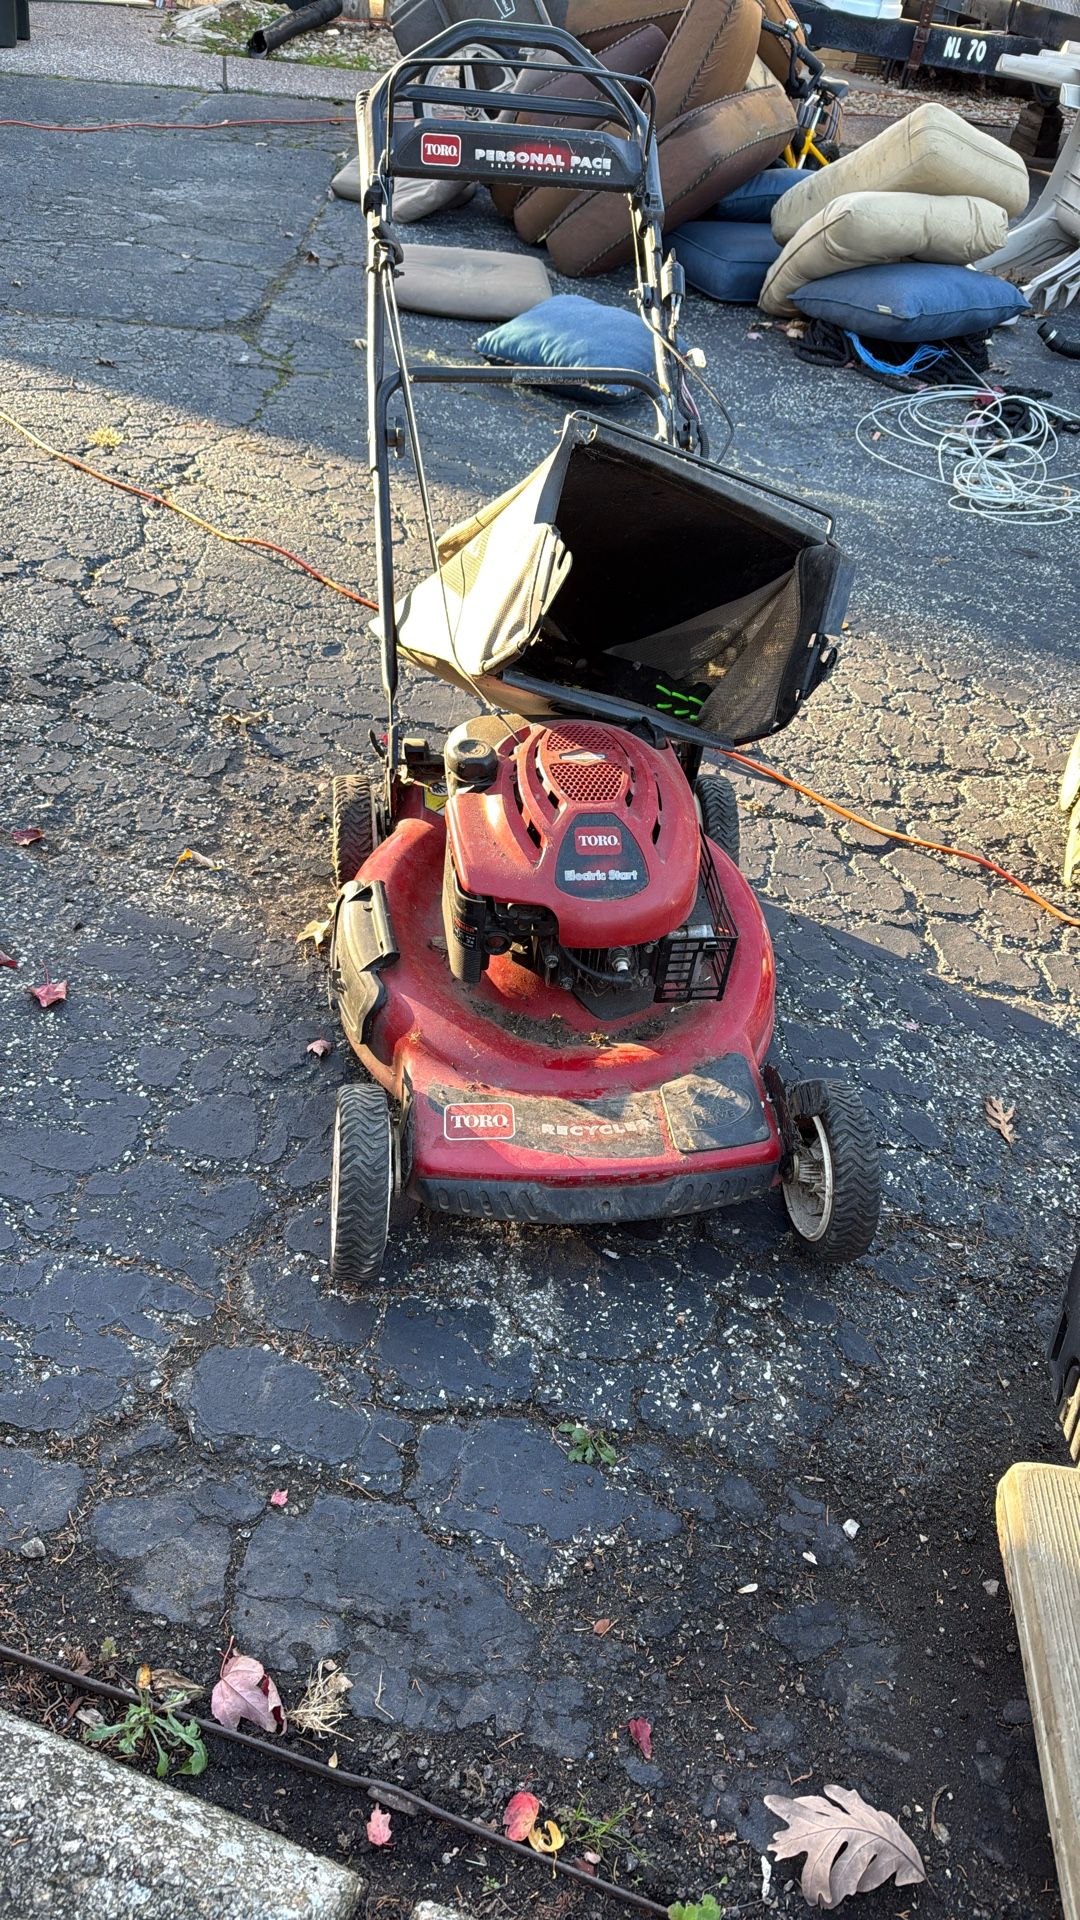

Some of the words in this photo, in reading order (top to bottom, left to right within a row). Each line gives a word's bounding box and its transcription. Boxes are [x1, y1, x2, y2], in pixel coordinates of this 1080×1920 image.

[943, 36, 962, 59] NL
[966, 38, 987, 62] 70
[424, 143, 458, 157] TORO
[475, 148, 566, 167] PERSONAL
[570, 156, 612, 170] PACE
[578, 835, 619, 847] TORO
[564, 870, 606, 881] Electric
[608, 869, 637, 881] Start
[450, 1113, 509, 1129] TORO
